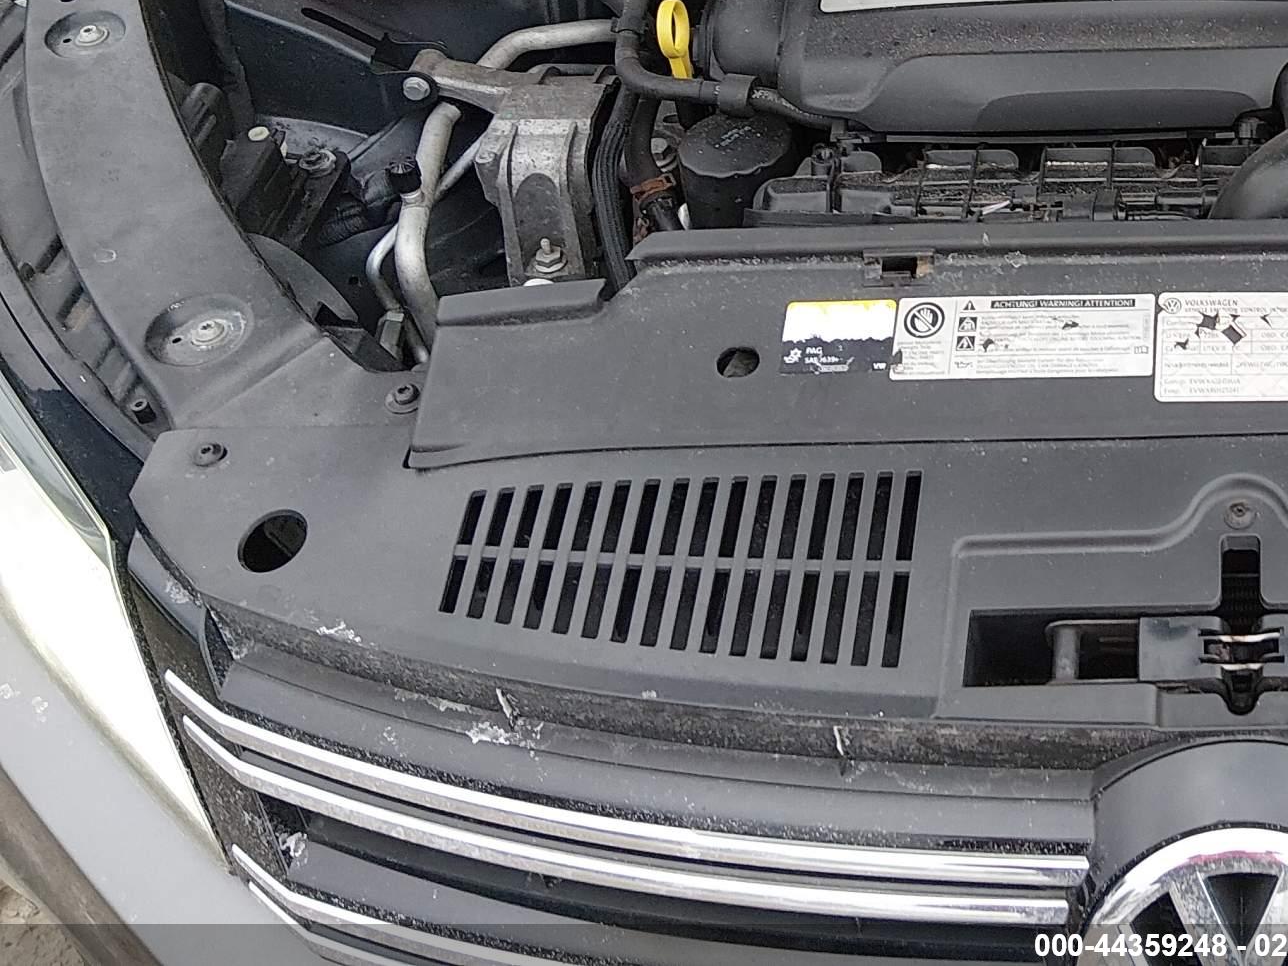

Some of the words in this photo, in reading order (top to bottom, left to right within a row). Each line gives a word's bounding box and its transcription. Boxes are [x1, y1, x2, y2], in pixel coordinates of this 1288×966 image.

[993, 301, 1038, 309] ACHTUNG!
[1040, 300, 1082, 308] WARNING!
[1083, 299, 1134, 308] ATTENTION!
[805, 346, 823, 355] PAG
[873, 362, 887, 370] VW
